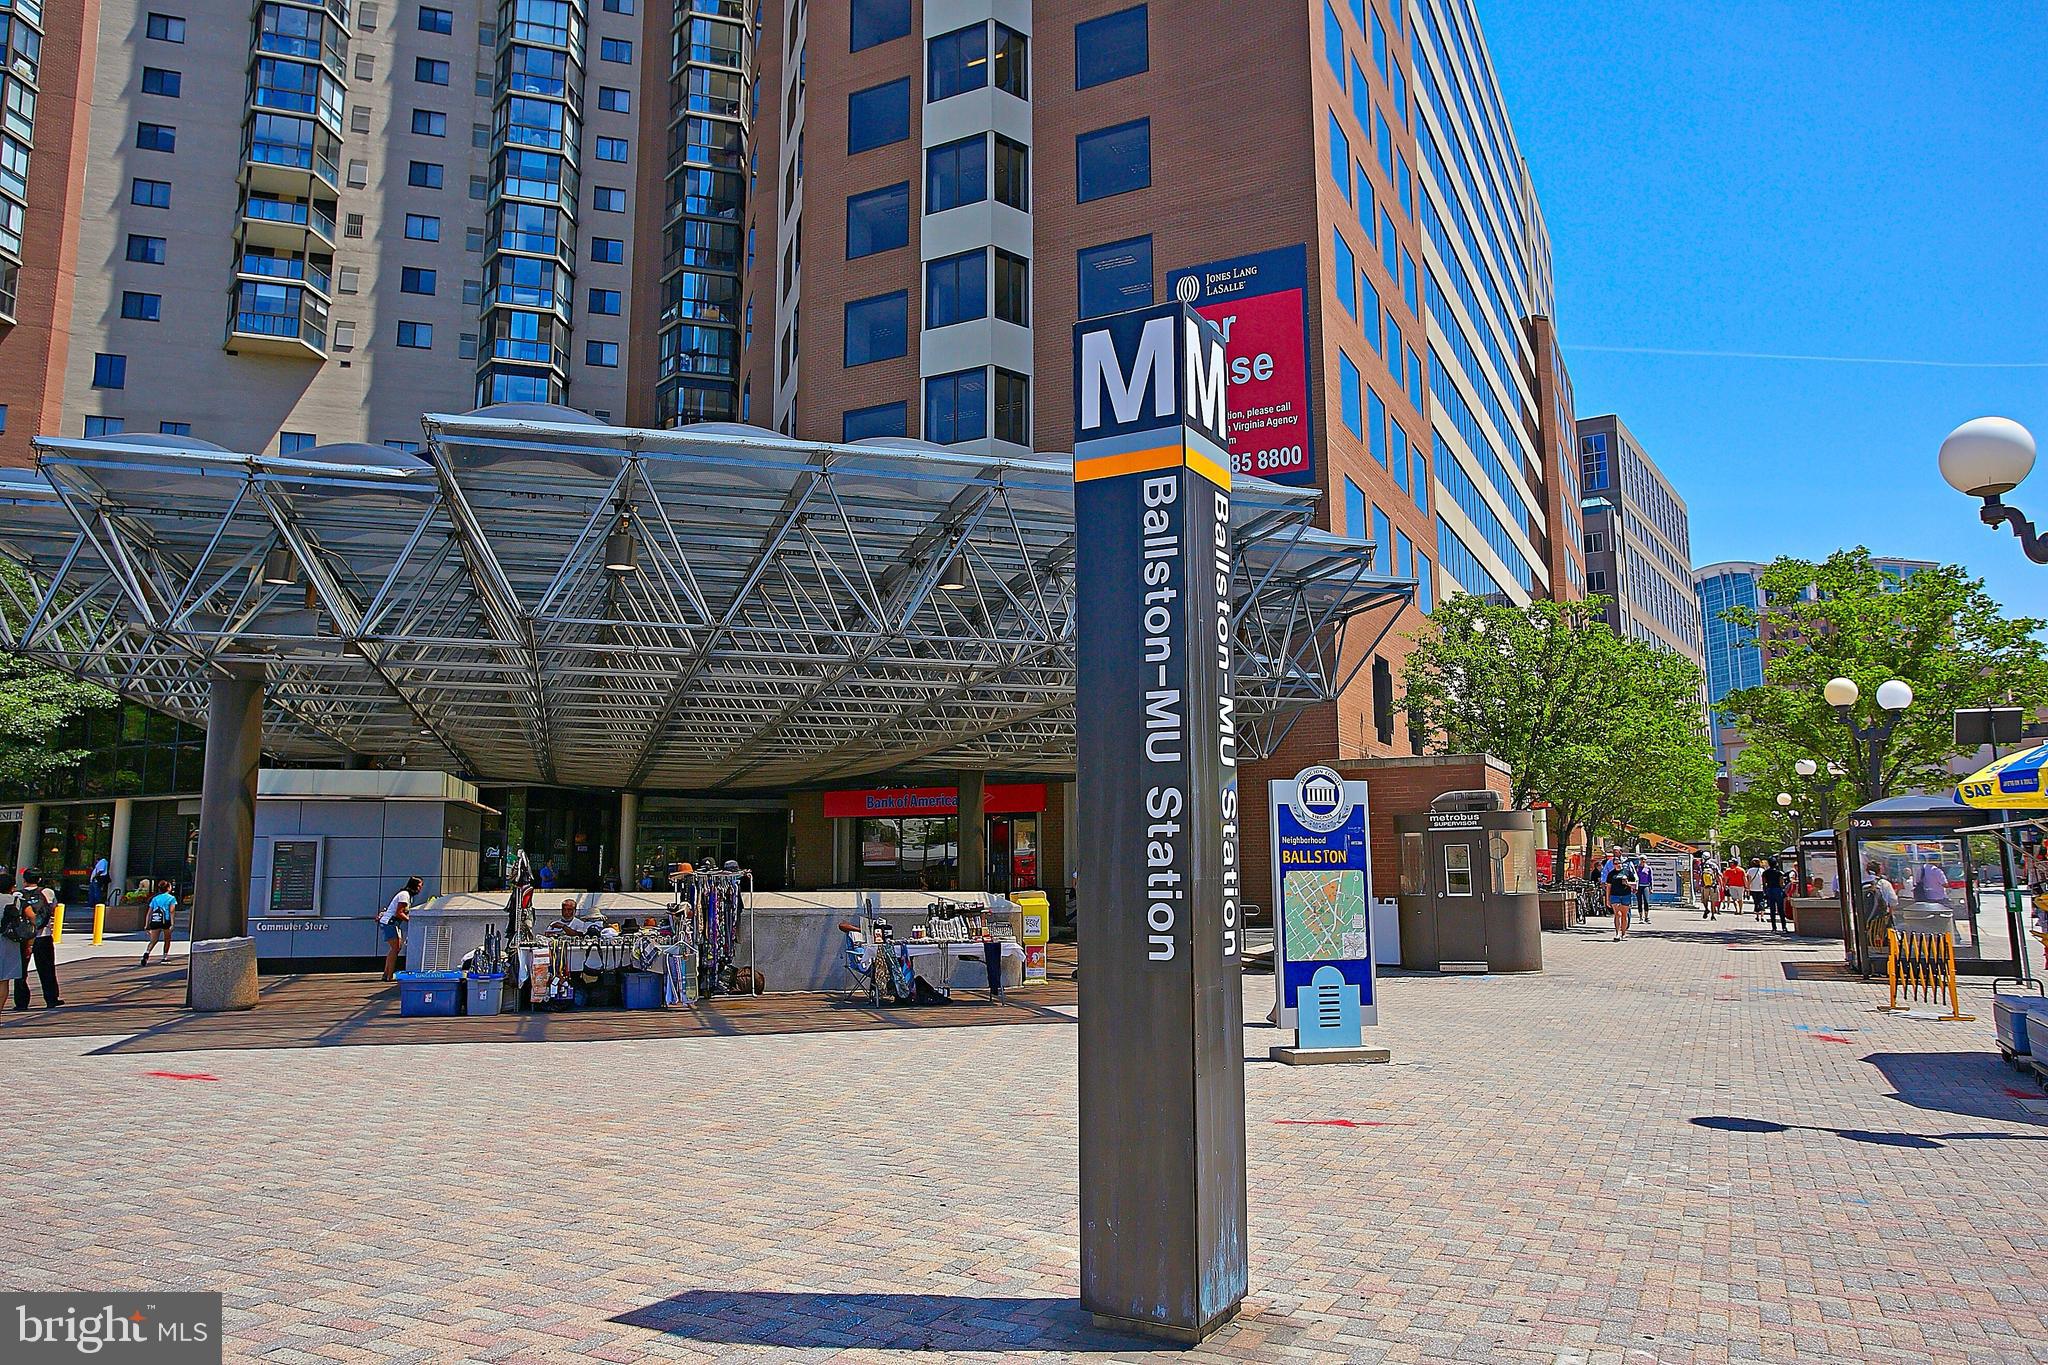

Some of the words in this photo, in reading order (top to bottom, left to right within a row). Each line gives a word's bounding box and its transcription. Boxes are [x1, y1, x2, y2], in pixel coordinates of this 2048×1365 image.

[1081, 315, 1175, 430] M
[1186, 315, 1226, 441] M
[1246, 404, 1274, 419] please
[1275, 401, 1291, 412] call
[1233, 420, 1265, 432] Virginia
[1266, 415, 1299, 428] Agency
[1257, 445, 1302, 470] 8800
[1142, 475, 1181, 763] Ballston-MU
[1214, 490, 1236, 767] Ballston-MU
[866, 795, 894, 809] Bank
[896, 794, 909, 808] of
[909, 792, 960, 808] America
[1430, 813, 1480, 821] metrobus
[1281, 836, 1327, 846] Neighborhood
[1282, 850, 1347, 864] BALLSTON
[1146, 786, 1184, 961] Station
[1221, 788, 1239, 957] Station
[256, 922, 303, 931] Commuter
[304, 921, 329, 931] Store
